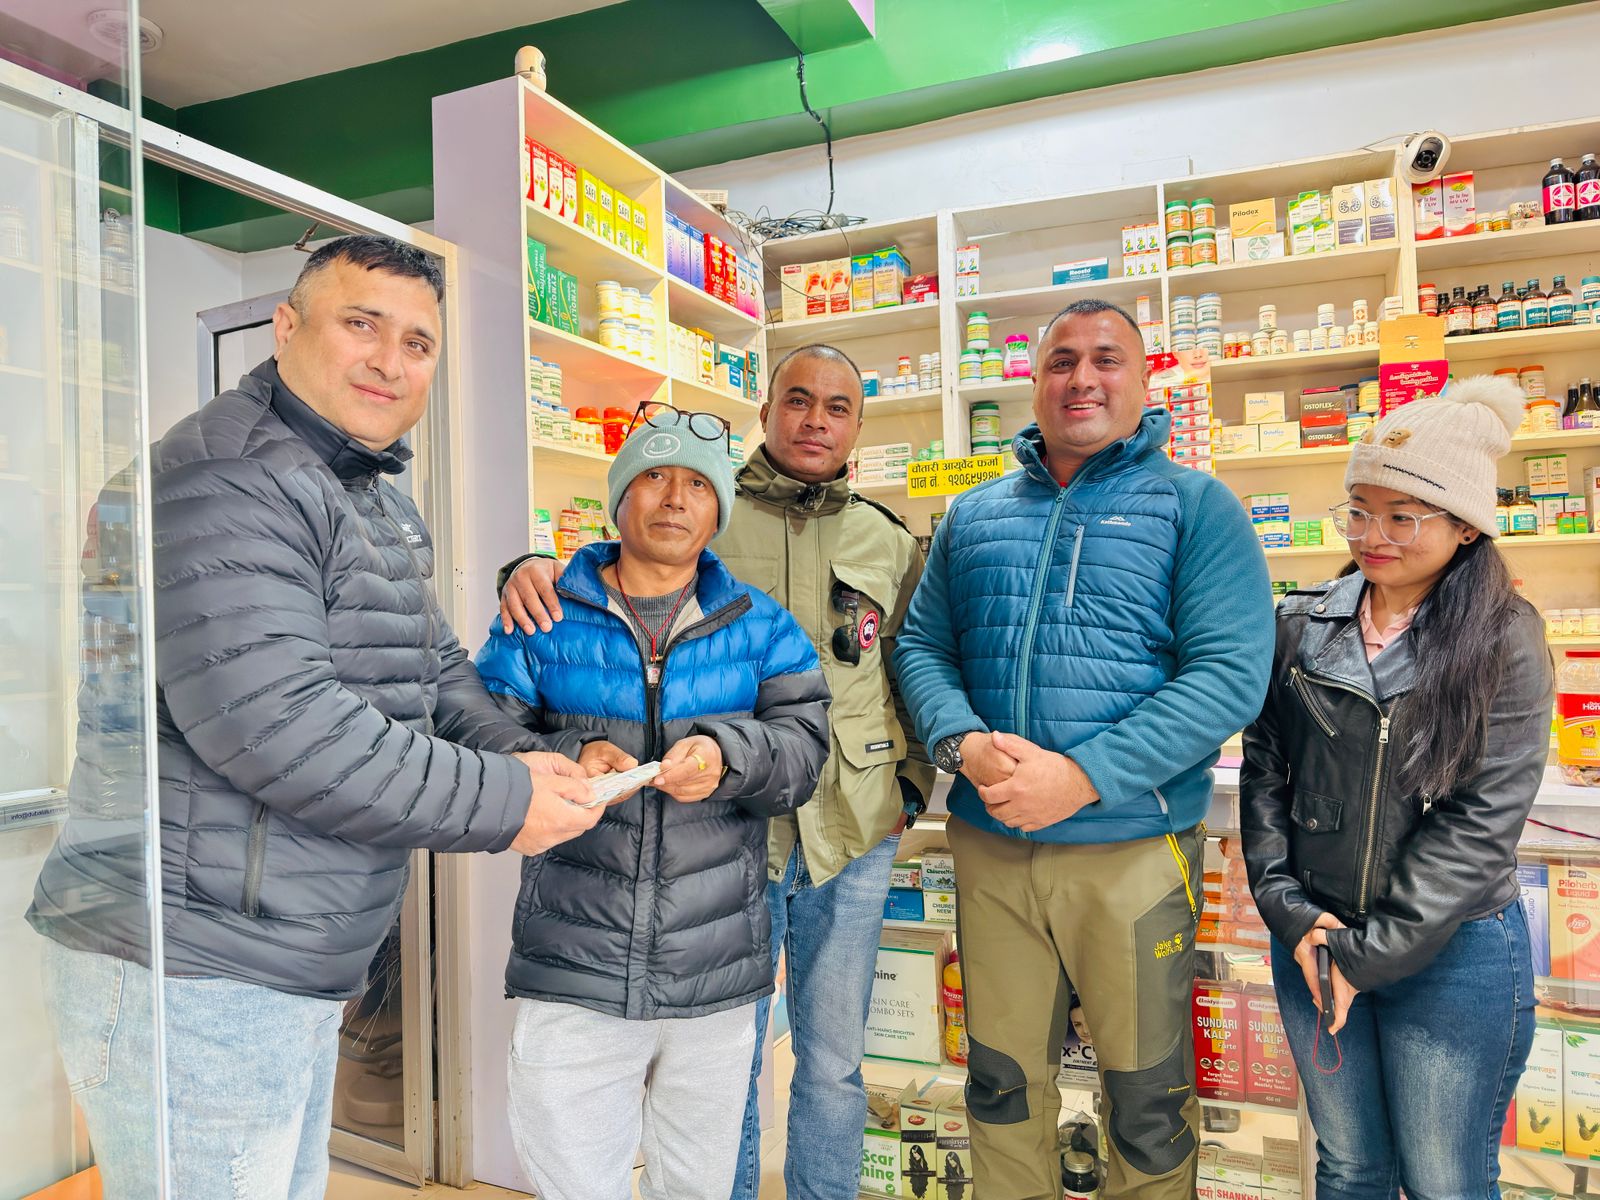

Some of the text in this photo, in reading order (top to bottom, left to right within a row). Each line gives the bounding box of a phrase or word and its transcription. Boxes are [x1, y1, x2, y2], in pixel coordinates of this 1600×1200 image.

[585, 184, 597, 202] SAFI
[601, 194, 613, 212] SAFI
[618, 204, 630, 222] SAFI
[1232, 209, 1259, 218] Pilodex
[634, 214, 646, 230] SAFI
[550, 273, 558, 317] ZYMOLIV
[570, 281, 578, 325] ZYMOLIV
[1498, 314, 1519, 322] Mentat
[1304, 402, 1334, 410] OSTOFLEX
[911, 476, 927, 489] पान
[1558, 880, 1597, 889] Piloherb
[1154, 940, 1172, 950] Jake
[889, 1000, 910, 1008] CARE
[1249, 1002, 1278, 1010] Baidyana
[870, 1006, 914, 1018] OMBO SETS
[1197, 1016, 1237, 1030] SUNDARI
[1248, 1021, 1286, 1035] SUNDAR
[1203, 1029, 1231, 1040] KALP
[1255, 1033, 1284, 1045] KALP
[1218, 1042, 1237, 1050] Forte
[863, 1149, 894, 1166] Scar
[862, 1164, 894, 1181] hine
